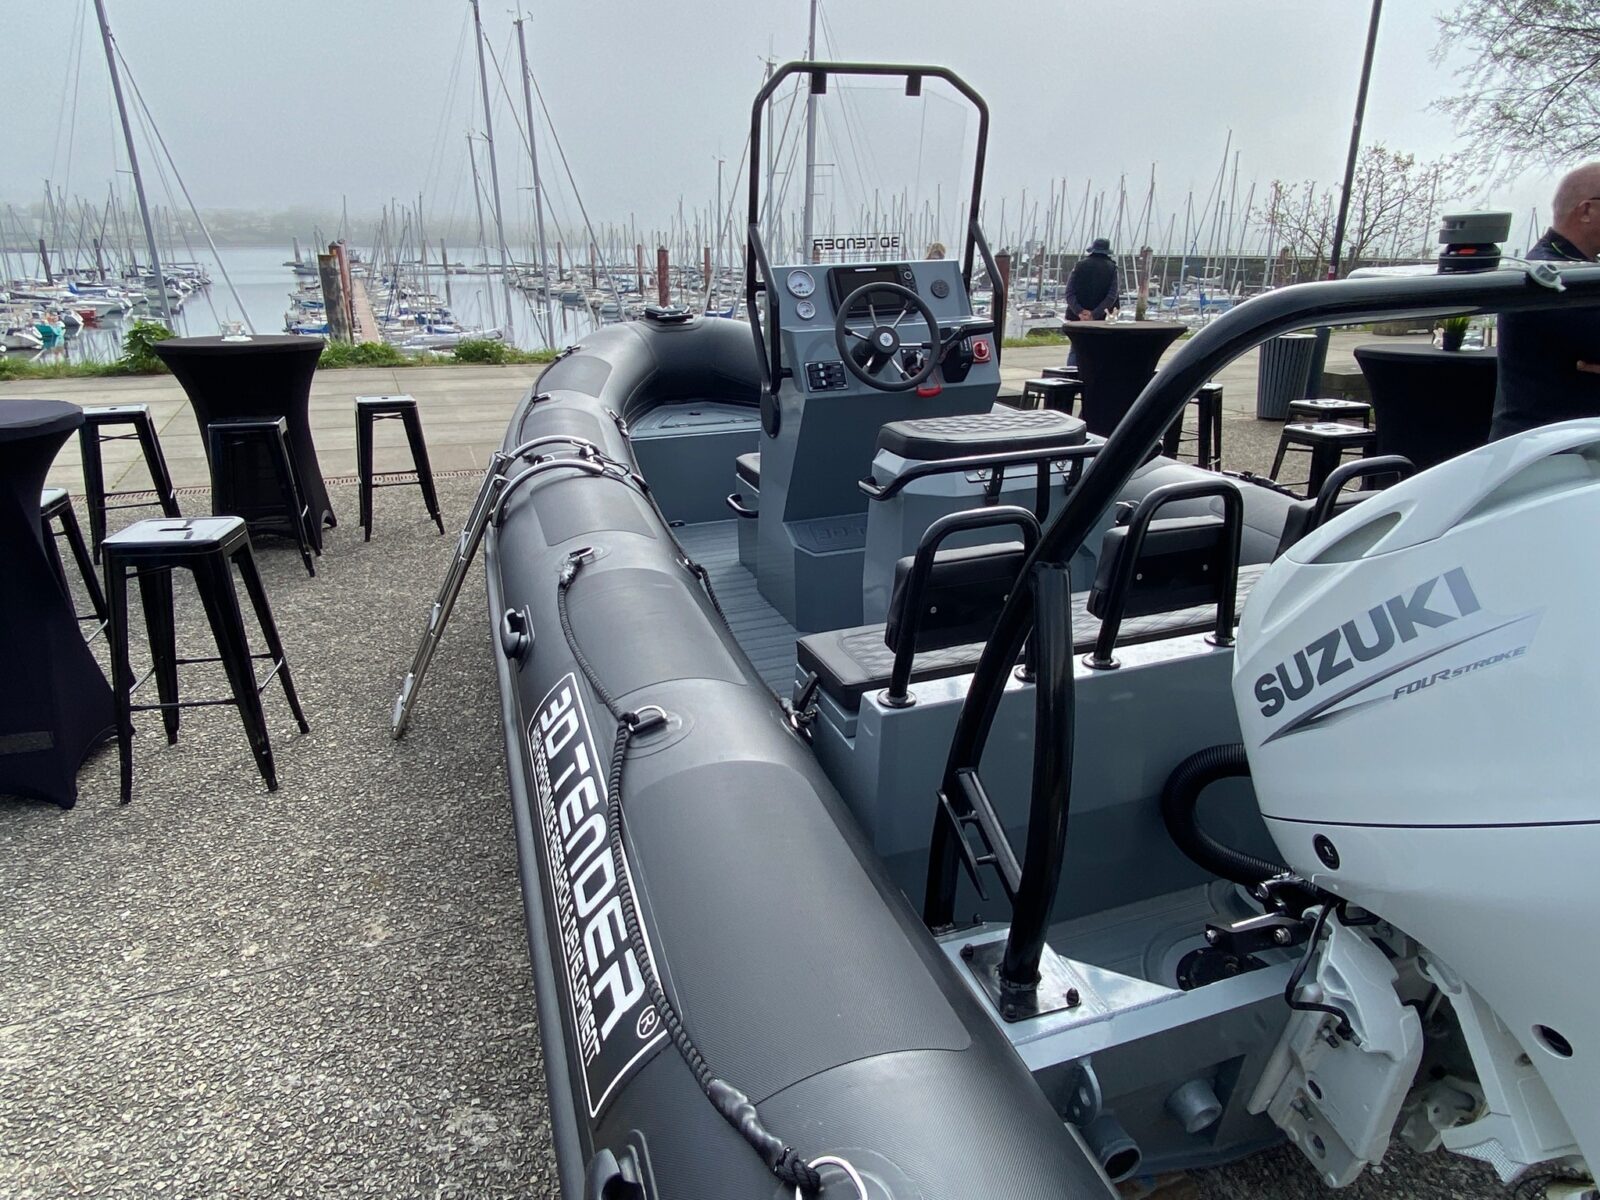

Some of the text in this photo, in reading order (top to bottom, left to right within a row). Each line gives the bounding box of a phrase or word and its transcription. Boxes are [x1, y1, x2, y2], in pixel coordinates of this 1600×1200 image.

[540, 686, 580, 760] 3D
[1254, 566, 1481, 717] SUZUKI
[548, 825, 572, 916] RESEARCH
[564, 915, 601, 1067] DEVELOPMENT
[554, 742, 645, 1041] TENDER
